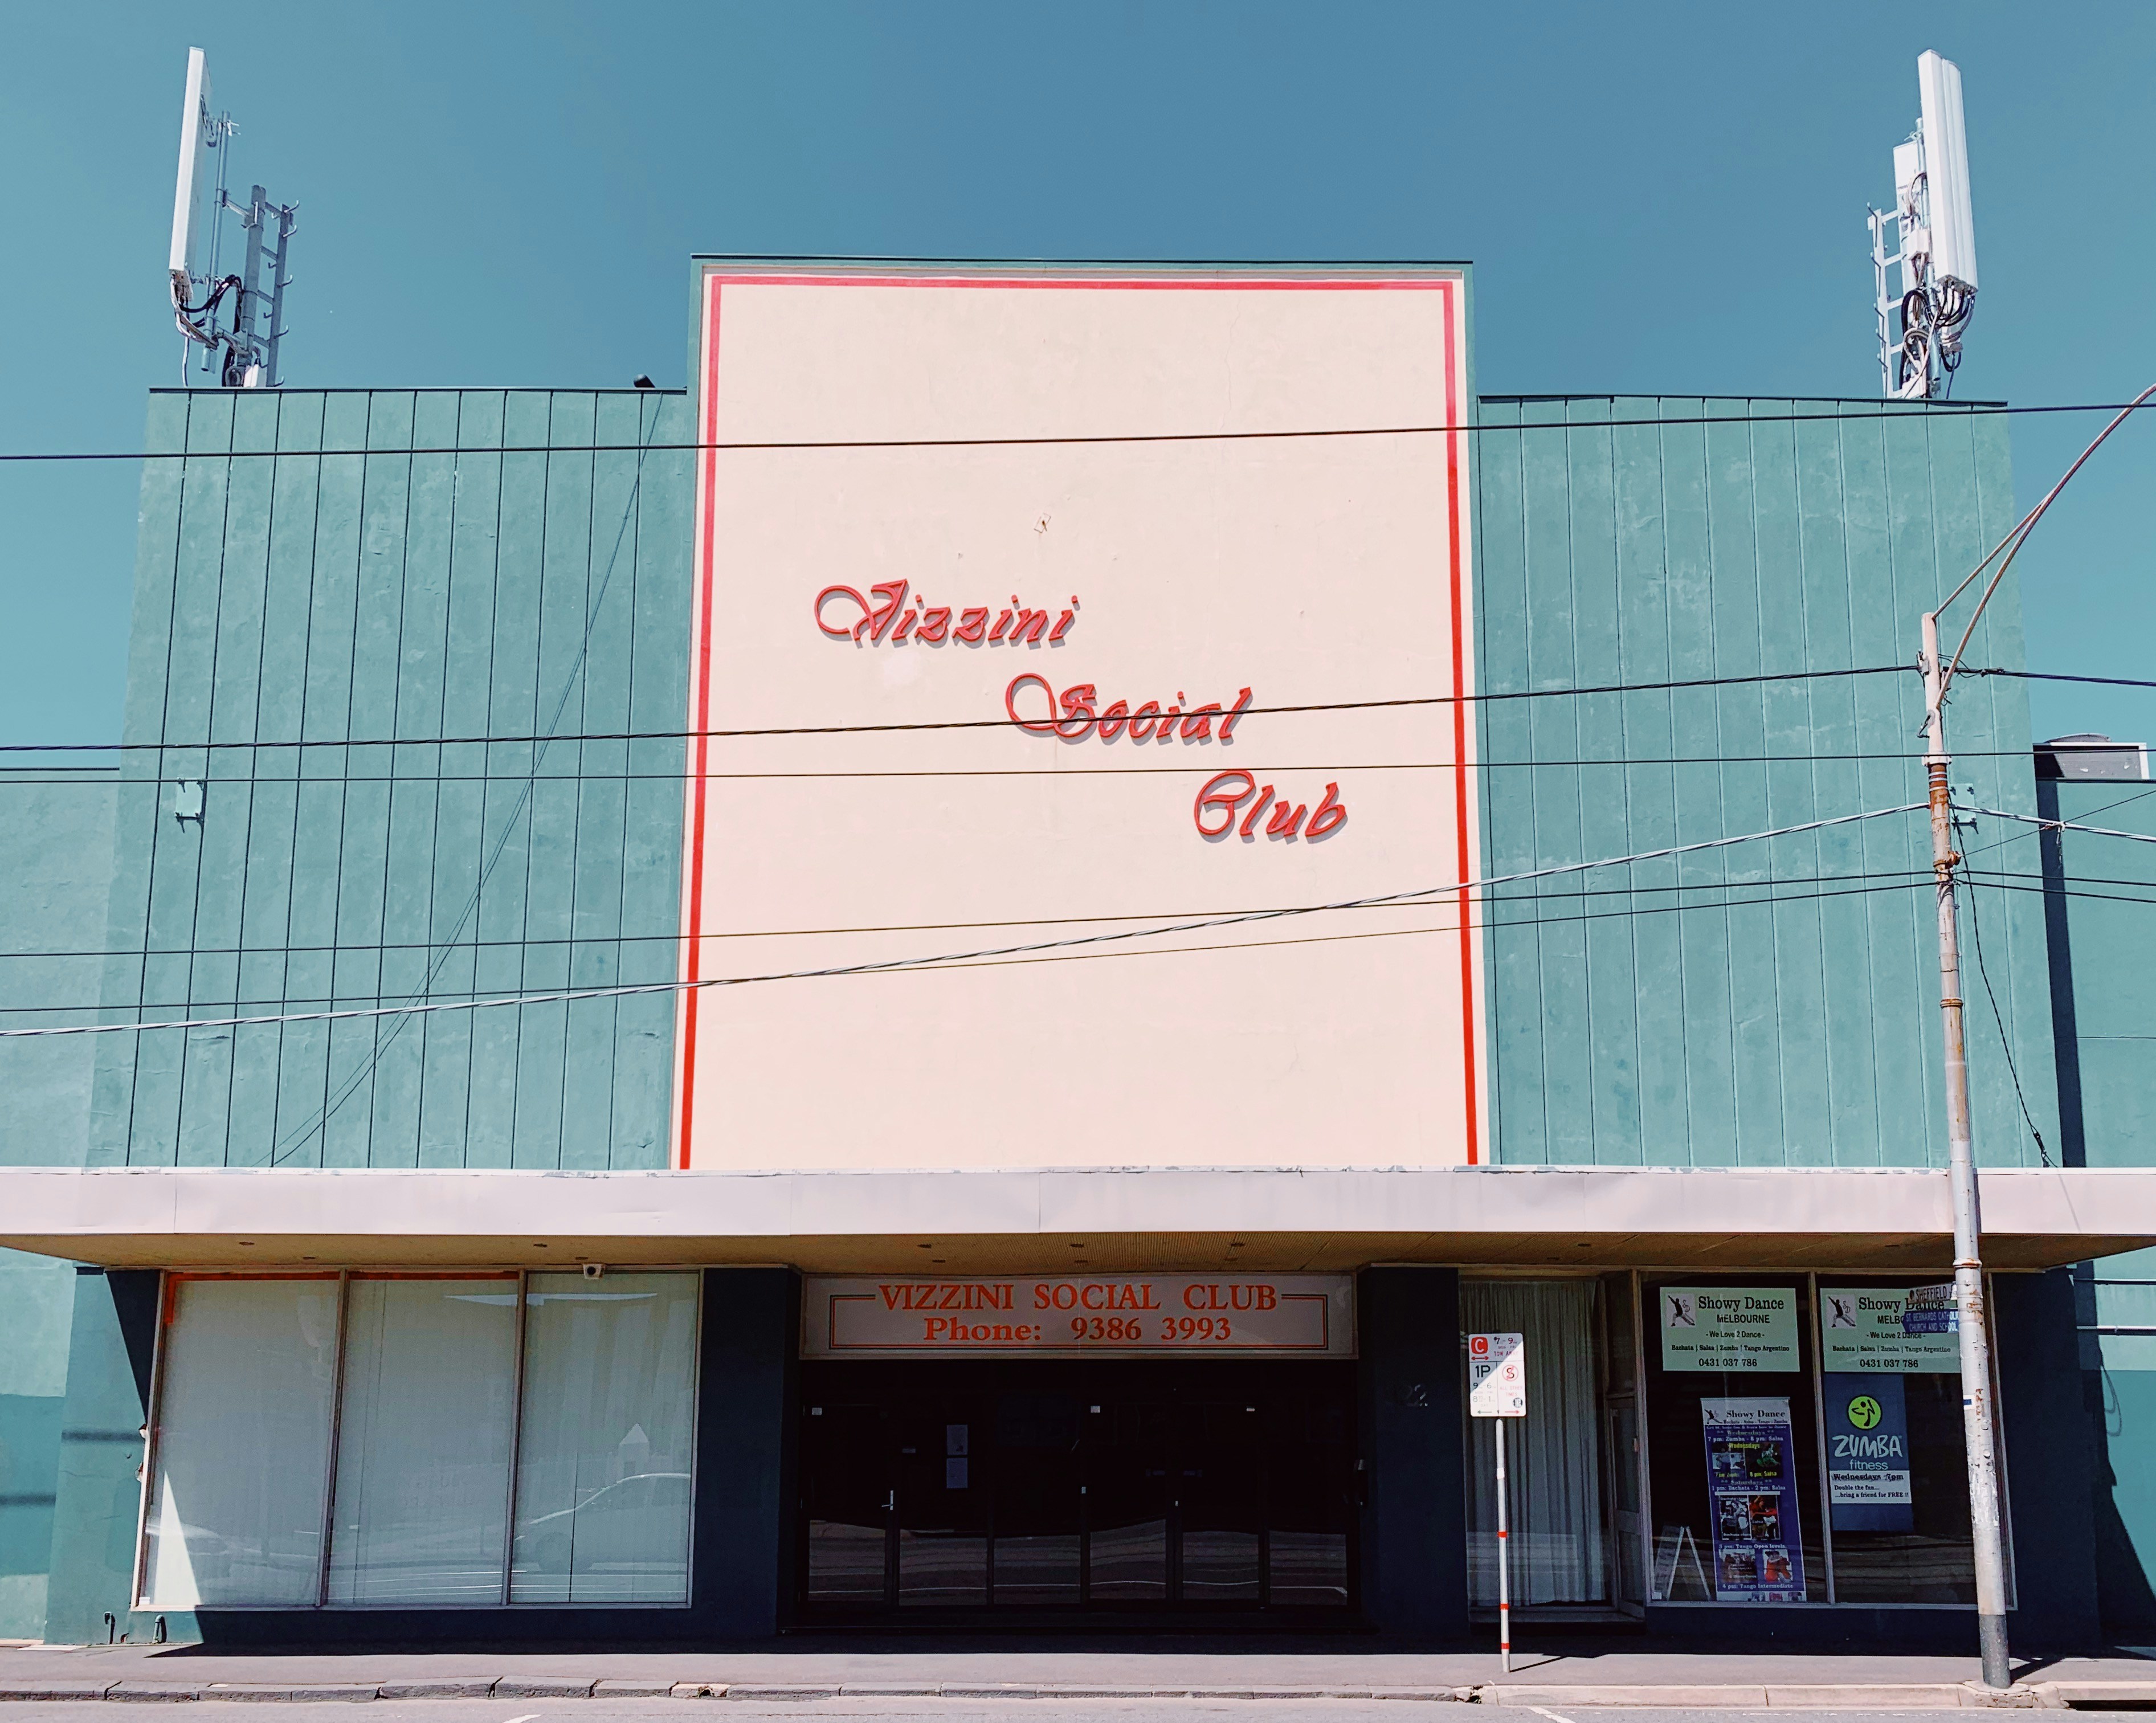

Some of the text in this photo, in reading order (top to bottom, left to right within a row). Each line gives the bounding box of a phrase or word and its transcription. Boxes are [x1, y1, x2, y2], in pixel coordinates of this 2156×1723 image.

[814, 578, 1079, 642] Vizzini
[1005, 672, 1251, 740] Social
[1194, 770, 1346, 838] Club
[879, 1284, 1277, 1311] VIZZINI SOCIAL CLUB
[1916, 1286, 1947, 1301] SHEFFIELD
[1698, 1296, 1785, 1312] Showy Dance
[1859, 1297, 1901, 1313] Showy
[1717, 1314, 1770, 1324] MELBOURNE
[1913, 1312, 1937, 1322] BERNARDS
[923, 1316, 1232, 1342] Phone: 9386 3993
[1909, 1321, 1958, 1332] CHURCH AND SCHOOL
[1475, 1338, 1483, 1352] C
[1698, 1358, 1758, 1367] 0431 037 786
[1860, 1359, 1881, 1368] 0431
[1902, 1359, 1918, 1368] 786
[1475, 1365, 1491, 1378] 1P
[1726, 1410, 1754, 1419] Showy
[1832, 1434, 1903, 1459] ZUMBA
[1849, 1459, 1889, 1470] fitness
